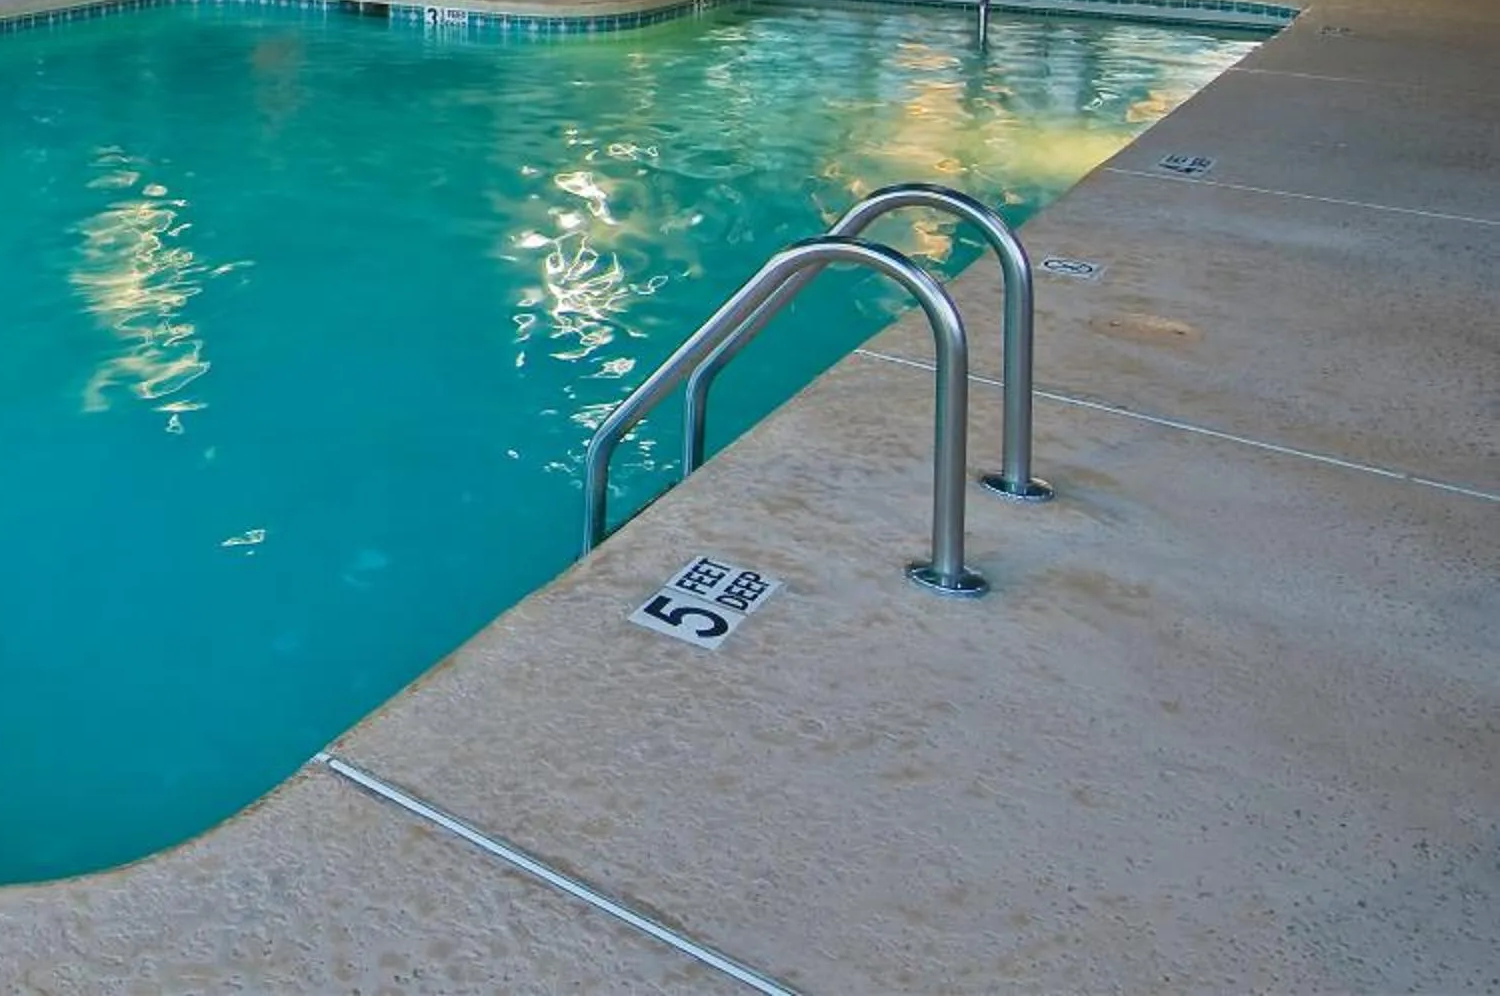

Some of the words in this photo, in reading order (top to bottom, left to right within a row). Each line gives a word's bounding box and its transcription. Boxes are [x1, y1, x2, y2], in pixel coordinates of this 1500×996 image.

[675, 558, 731, 596] FEET
[715, 571, 770, 611] DEEP
[643, 595, 729, 638] 5
